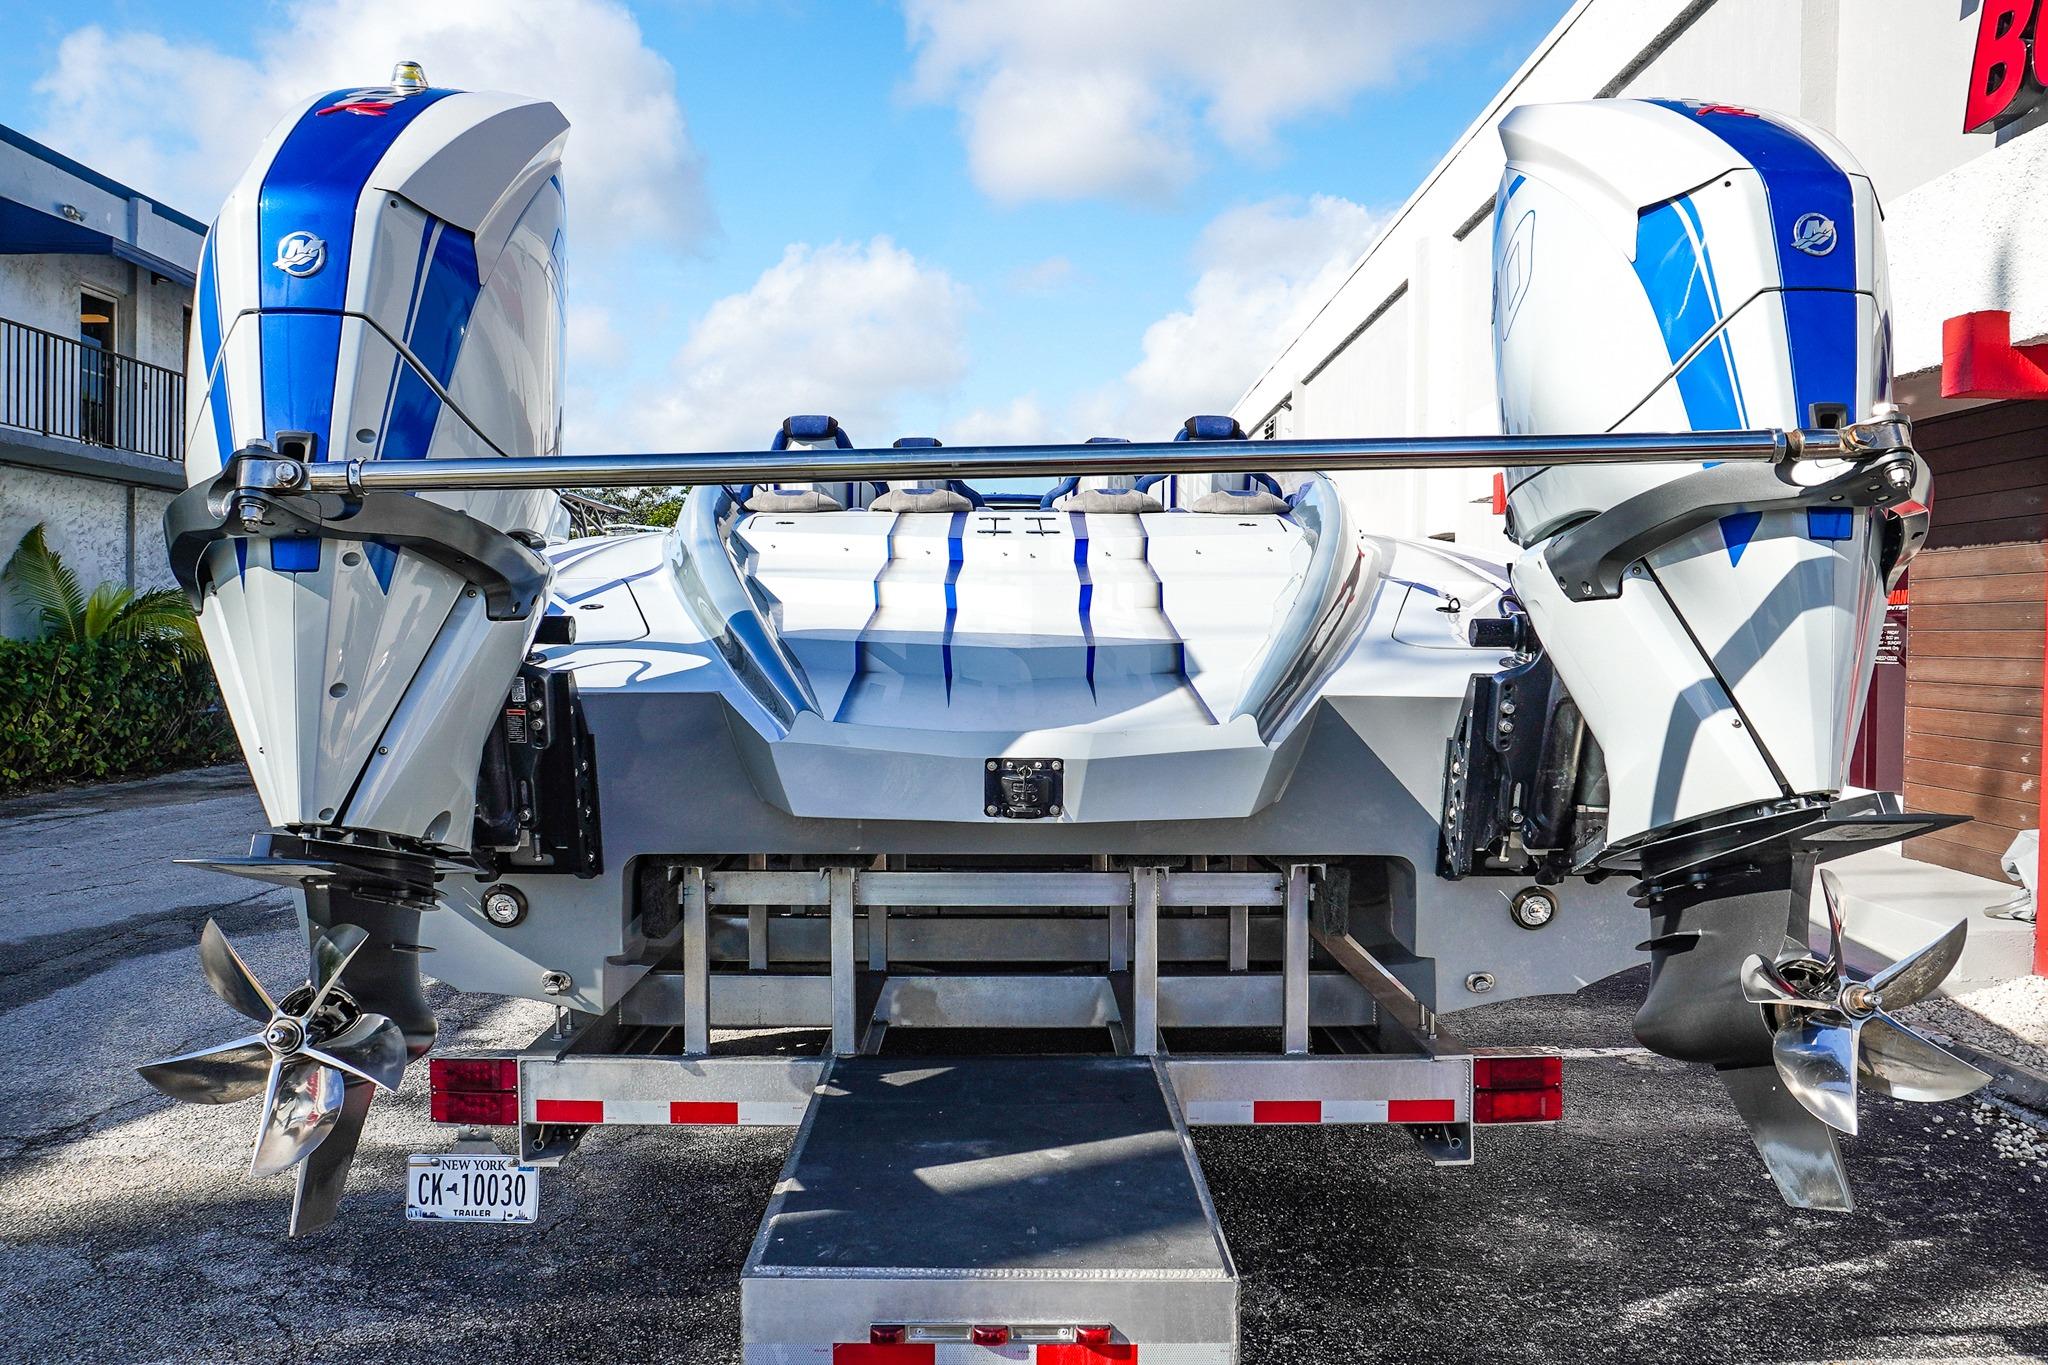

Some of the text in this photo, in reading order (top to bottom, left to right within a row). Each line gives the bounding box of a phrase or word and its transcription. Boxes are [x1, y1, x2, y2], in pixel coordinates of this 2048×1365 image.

[1962, 0, 2048, 134] B
[441, 1160, 506, 1171] NEW YORK
[453, 1209, 491, 1217] TRAILER
